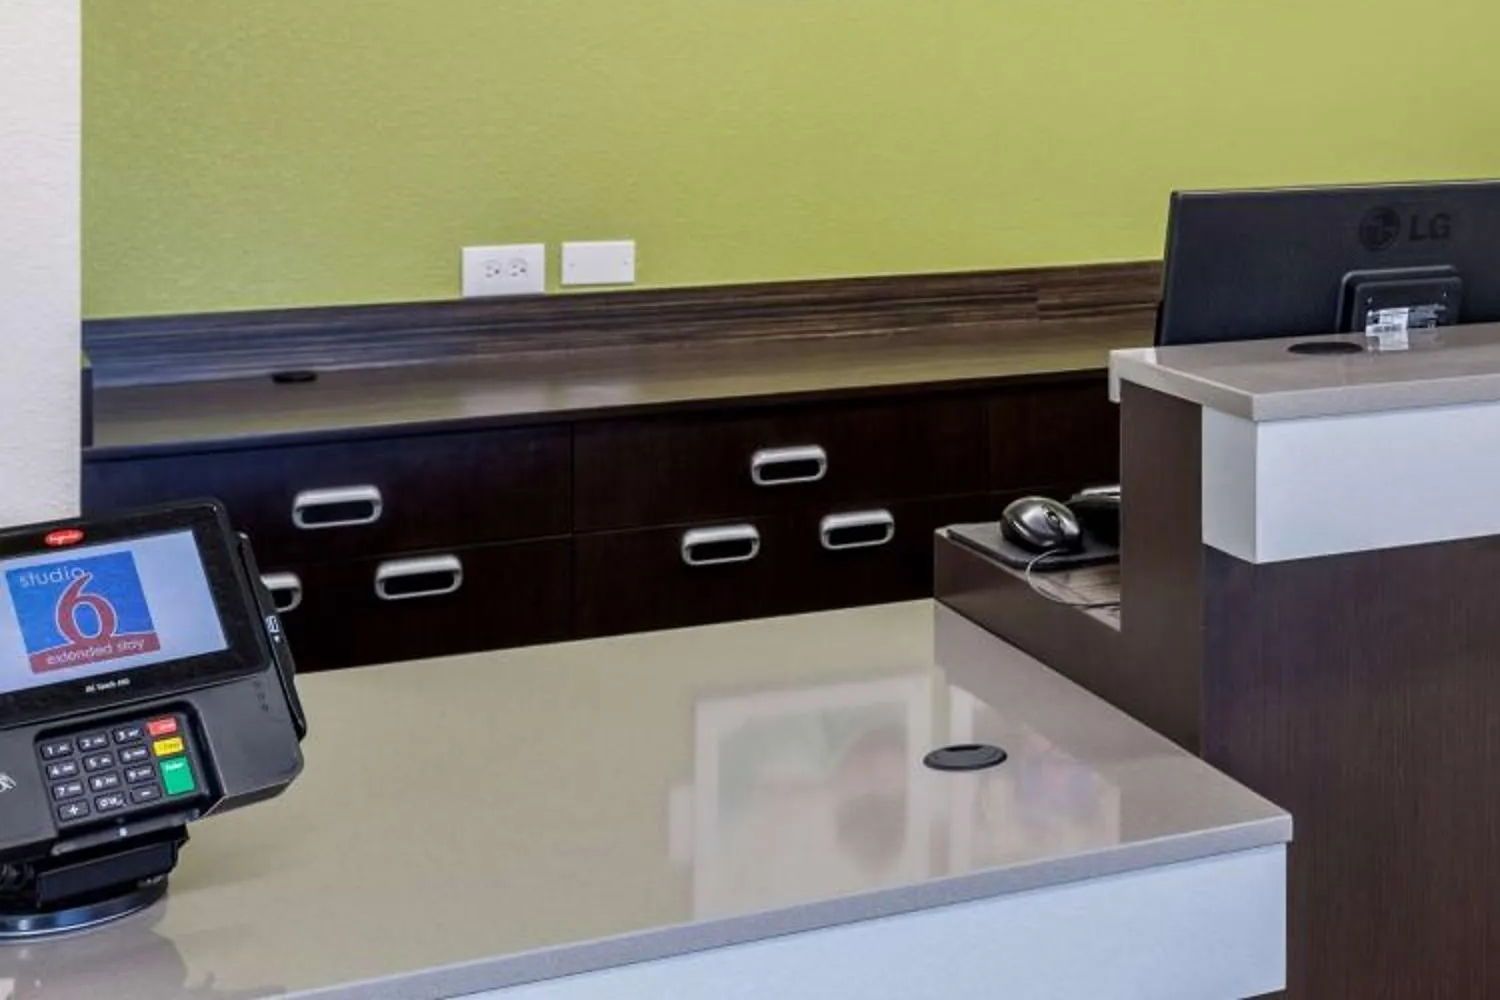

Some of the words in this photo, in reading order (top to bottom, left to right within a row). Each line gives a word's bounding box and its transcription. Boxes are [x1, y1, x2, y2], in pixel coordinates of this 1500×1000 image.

[1408, 213, 1451, 242] LG
[19, 566, 86, 588] studio
[55, 572, 118, 643] 6
[46, 643, 113, 665] extended
[117, 638, 145, 650] stay
